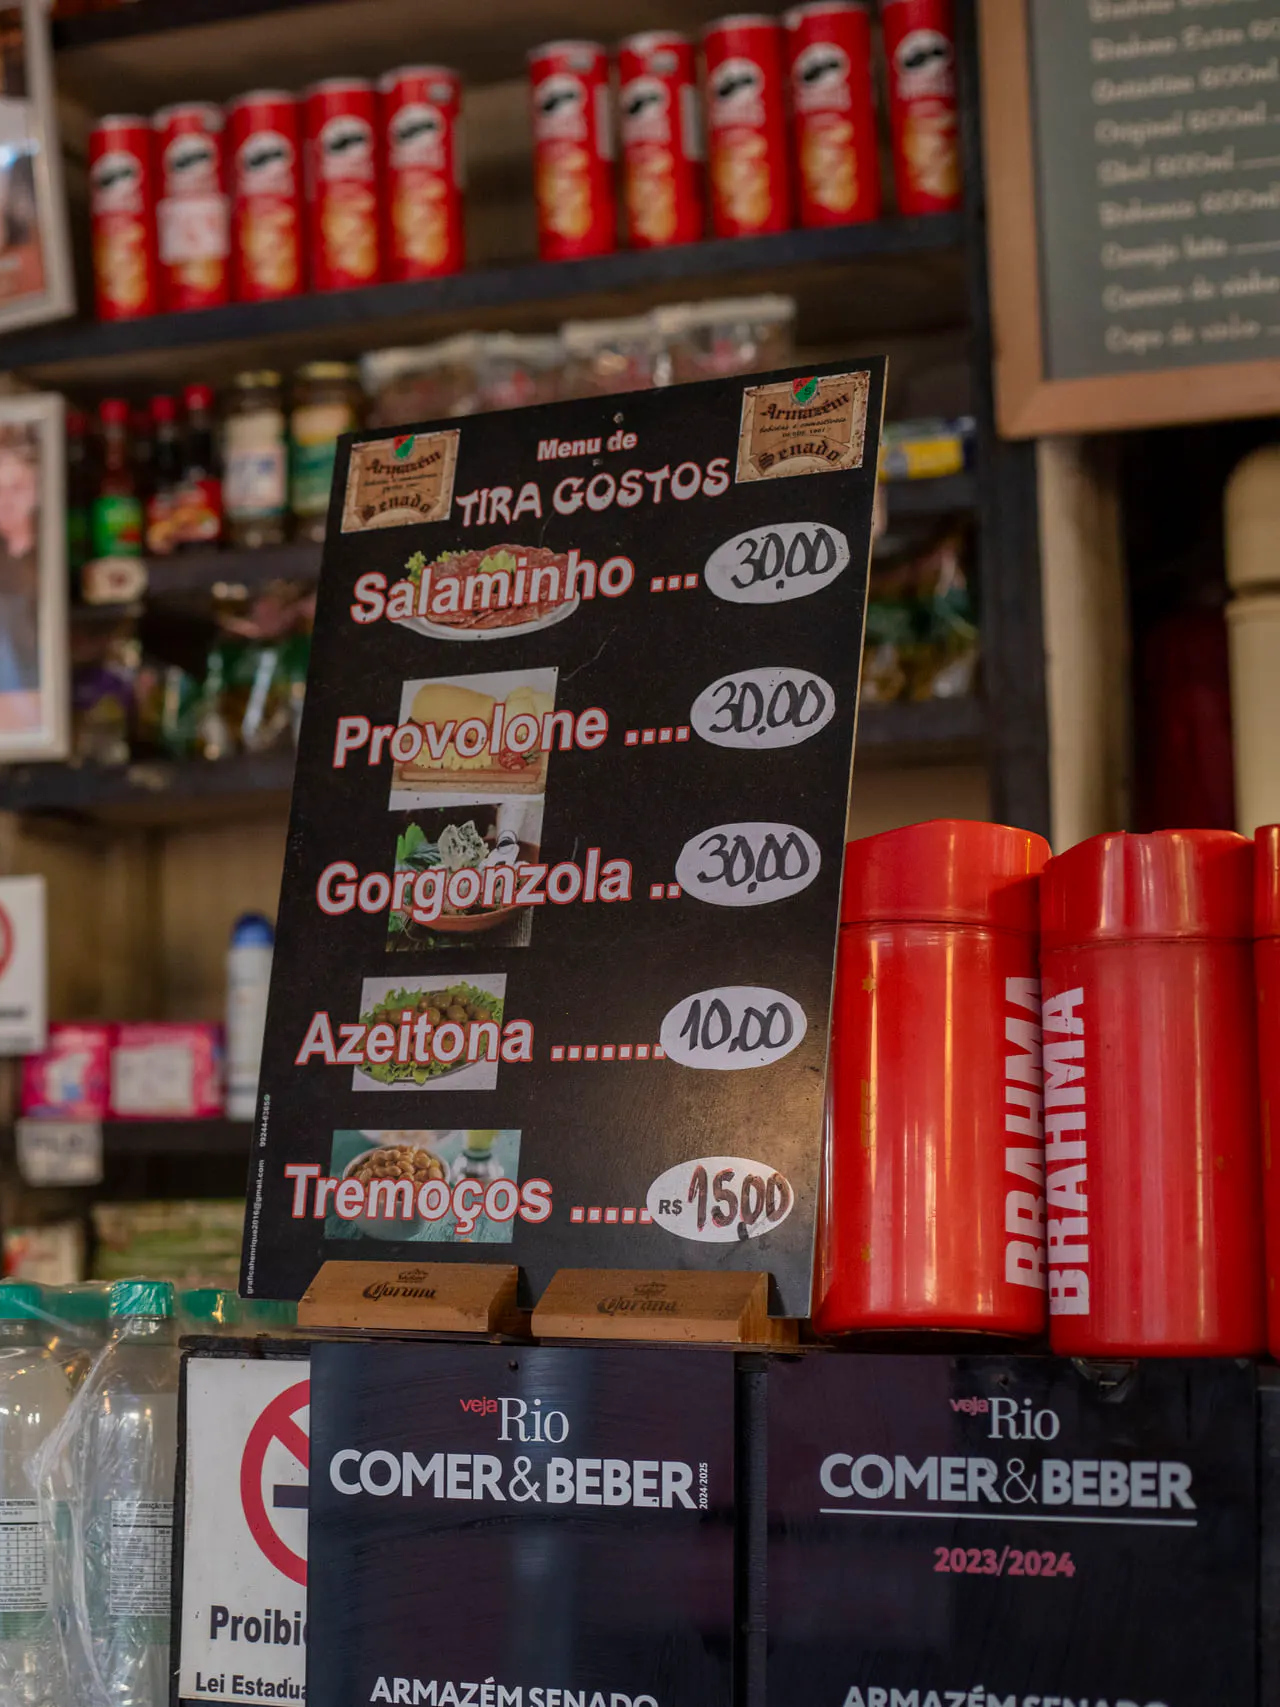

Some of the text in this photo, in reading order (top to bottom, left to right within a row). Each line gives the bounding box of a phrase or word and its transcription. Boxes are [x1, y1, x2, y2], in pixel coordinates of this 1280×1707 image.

[536, 430, 637, 461] Menu de
[456, 457, 730, 528] TIRA GOSTOS
[350, 548, 636, 624] Salaminho
[332, 702, 610, 769] Provolone
[317, 847, 633, 922] Gorgonzola
[295, 1010, 534, 1066] Azeitona
[680, 998, 794, 1054] 10,00
[1042, 986, 1090, 1316] BRAHMA
[284, 1162, 553, 1234] Tremoços
[658, 1198, 683, 1217] R$
[459, 1396, 570, 1443] veja Rio
[949, 1396, 1060, 1441] veja Rio
[699, 1462, 709, 1510] 2024/2025
[933, 1545, 1076, 1578] 2023/2024
[210, 1605, 307, 1646] Proibi
[195, 1672, 225, 1694] Lei
[370, 1676, 523, 1707] ARMAZÉM
